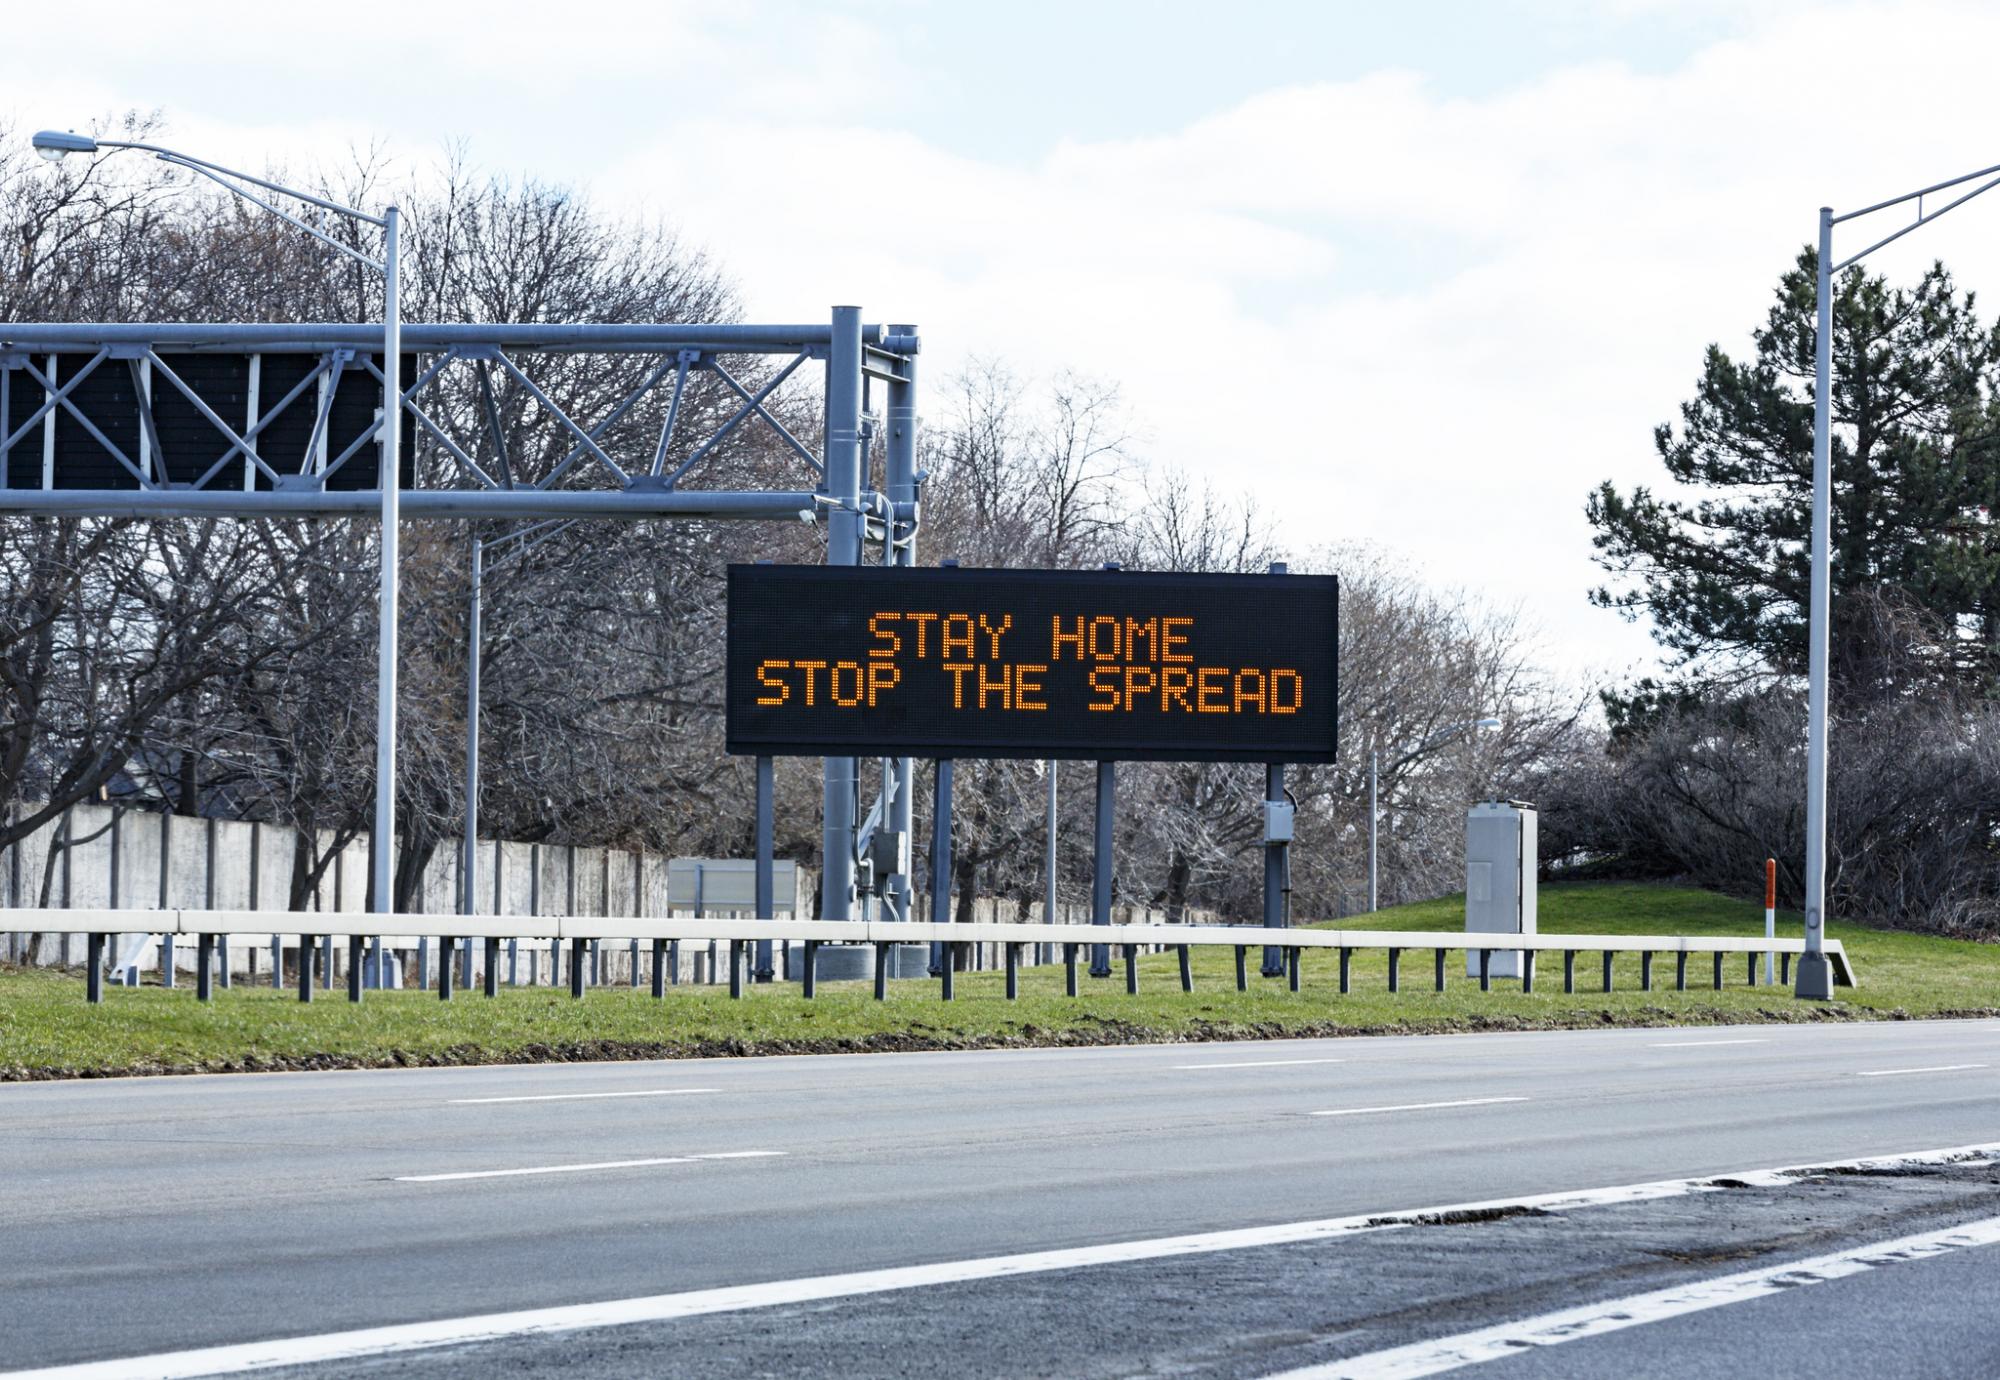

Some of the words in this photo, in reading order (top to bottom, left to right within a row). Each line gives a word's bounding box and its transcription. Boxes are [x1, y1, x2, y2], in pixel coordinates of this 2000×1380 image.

[869, 612, 1012, 659] STAY
[1052, 615, 1194, 663] HOME
[757, 660, 901, 707] STOP
[943, 663, 1047, 710] THE
[1088, 665, 1302, 714] SPREAD
